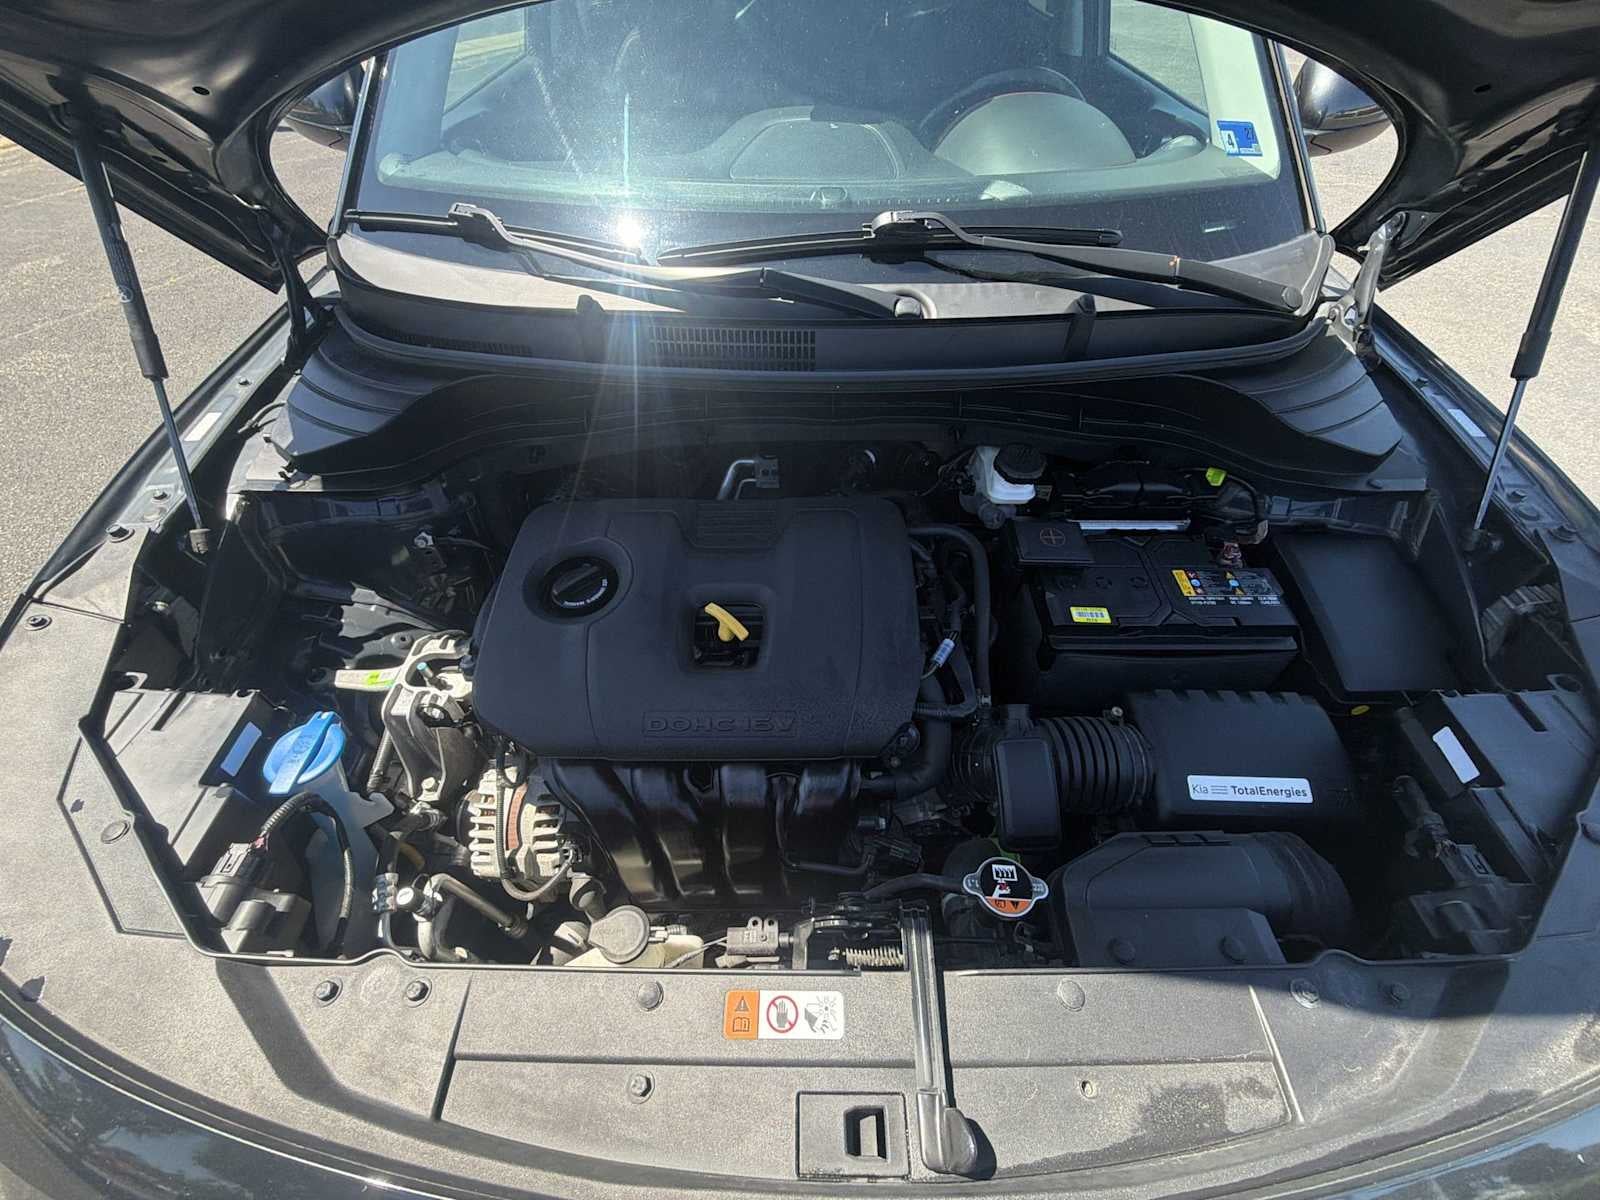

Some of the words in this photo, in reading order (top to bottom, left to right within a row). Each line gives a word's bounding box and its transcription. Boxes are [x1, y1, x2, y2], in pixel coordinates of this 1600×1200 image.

[1227, 133, 1235, 148] 4
[647, 716, 735, 733] DOHC
[1191, 784, 1208, 795] Kia
[1230, 785, 1308, 798] TotalEnergies
